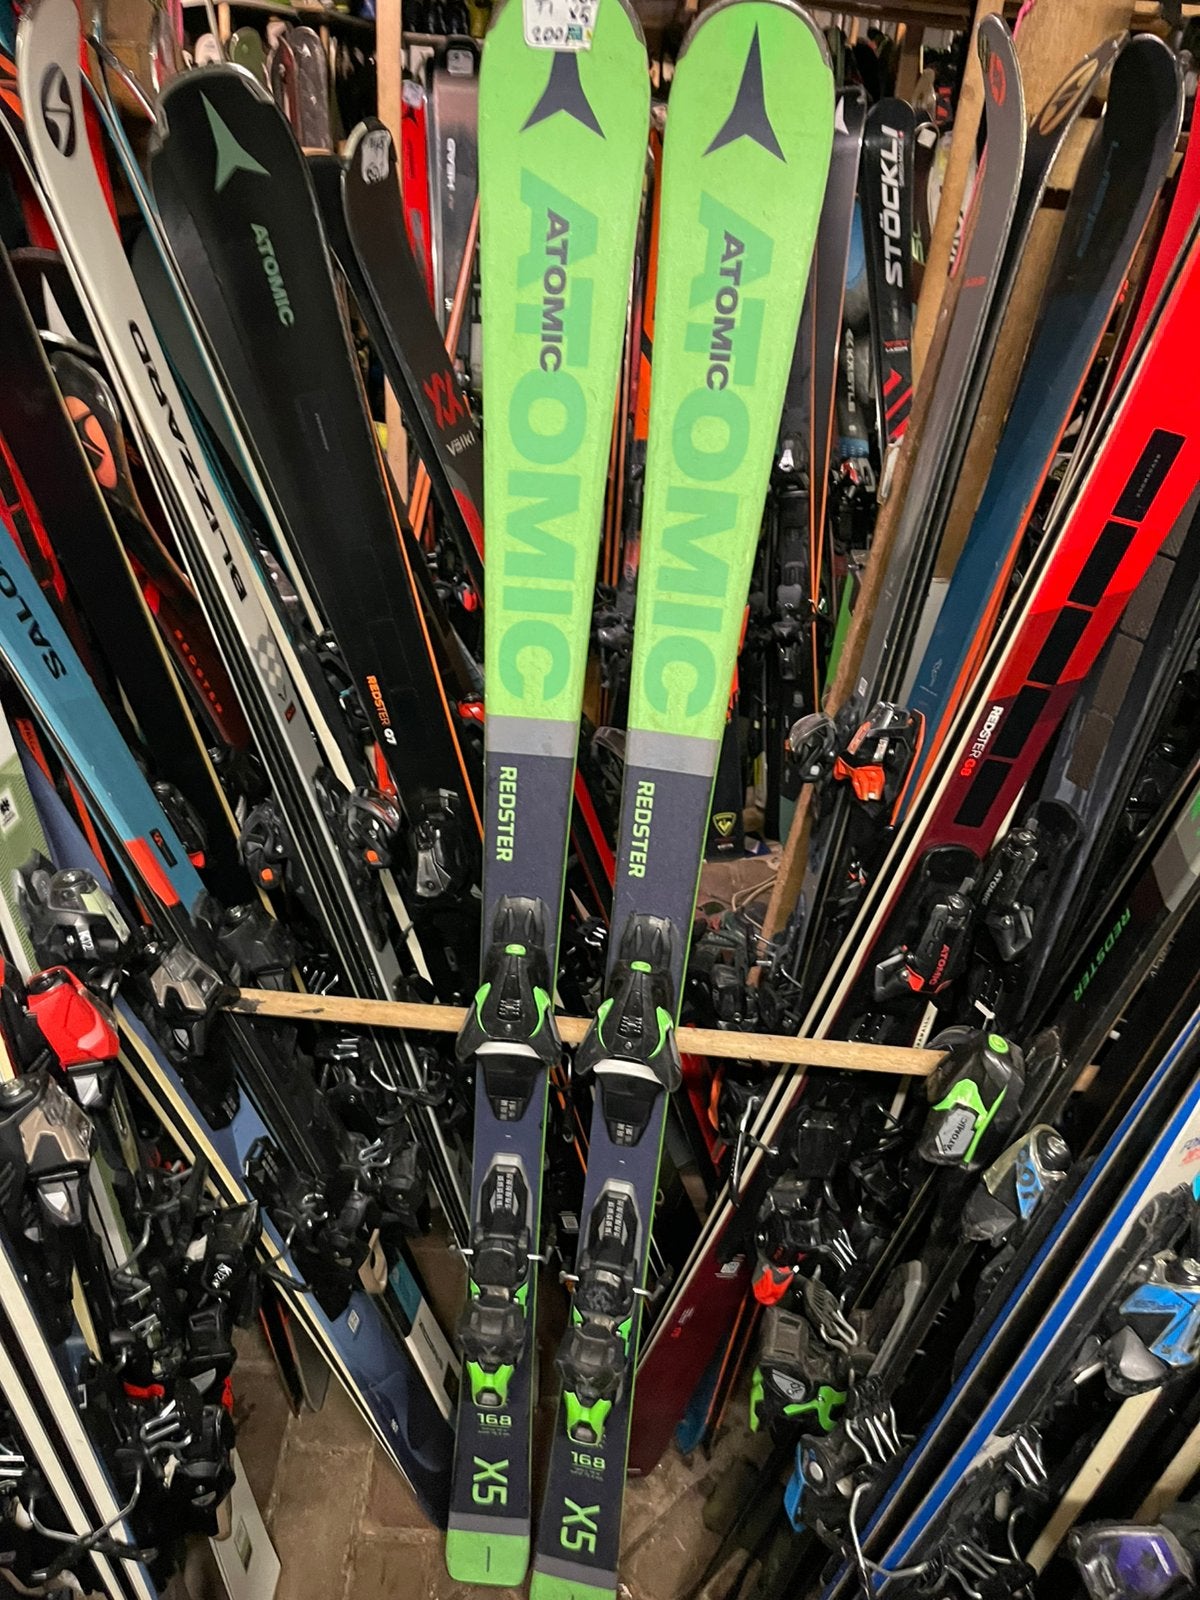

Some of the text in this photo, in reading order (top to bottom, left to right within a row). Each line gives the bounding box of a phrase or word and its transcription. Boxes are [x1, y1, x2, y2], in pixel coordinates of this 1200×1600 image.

[879, 124, 904, 289] STÖCKLI
[251, 223, 295, 328] ATOMIC
[538, 207, 570, 373] ATOMIC
[706, 229, 746, 391] ATOMIC
[128, 319, 248, 602] BLIZZARD
[499, 166, 599, 702] ATOMIC
[643, 189, 775, 718] ATOMIC
[0, 560, 68, 680] SALO
[366, 674, 392, 728] REDSTER
[968, 705, 1005, 758] REDSTER
[496, 766, 518, 862] REDSTER
[628, 781, 656, 878] REDSTER
[981, 869, 1004, 907] ATOMIC
[929, 944, 951, 986] ATOMIC
[1074, 907, 1131, 1002] REDSTER
[945, 1116, 968, 1152] ATOMIC
[476, 1413, 512, 1426] 168
[570, 1451, 606, 1470] 168
[472, 1455, 510, 1506] X5
[560, 1497, 600, 1554] X5
